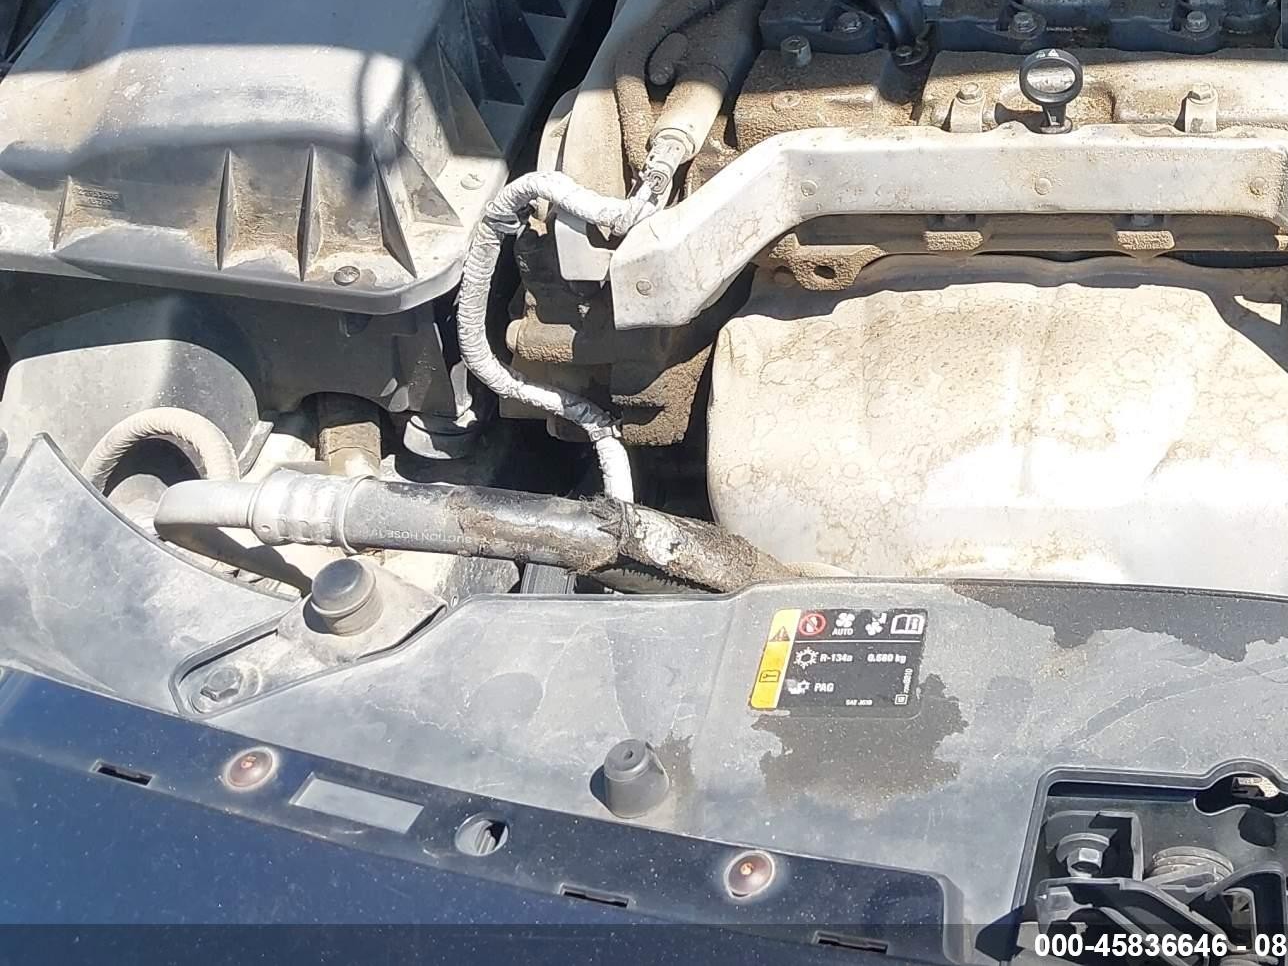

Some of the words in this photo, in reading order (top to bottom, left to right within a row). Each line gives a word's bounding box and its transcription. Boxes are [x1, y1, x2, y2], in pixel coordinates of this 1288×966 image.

[386, 530, 419, 541] HOSE
[421, 532, 473, 544] SUCTION
[832, 628, 854, 636] AUTO
[819, 653, 853, 663] R-134a
[895, 653, 907, 664] kg
[813, 682, 835, 693] PAG
